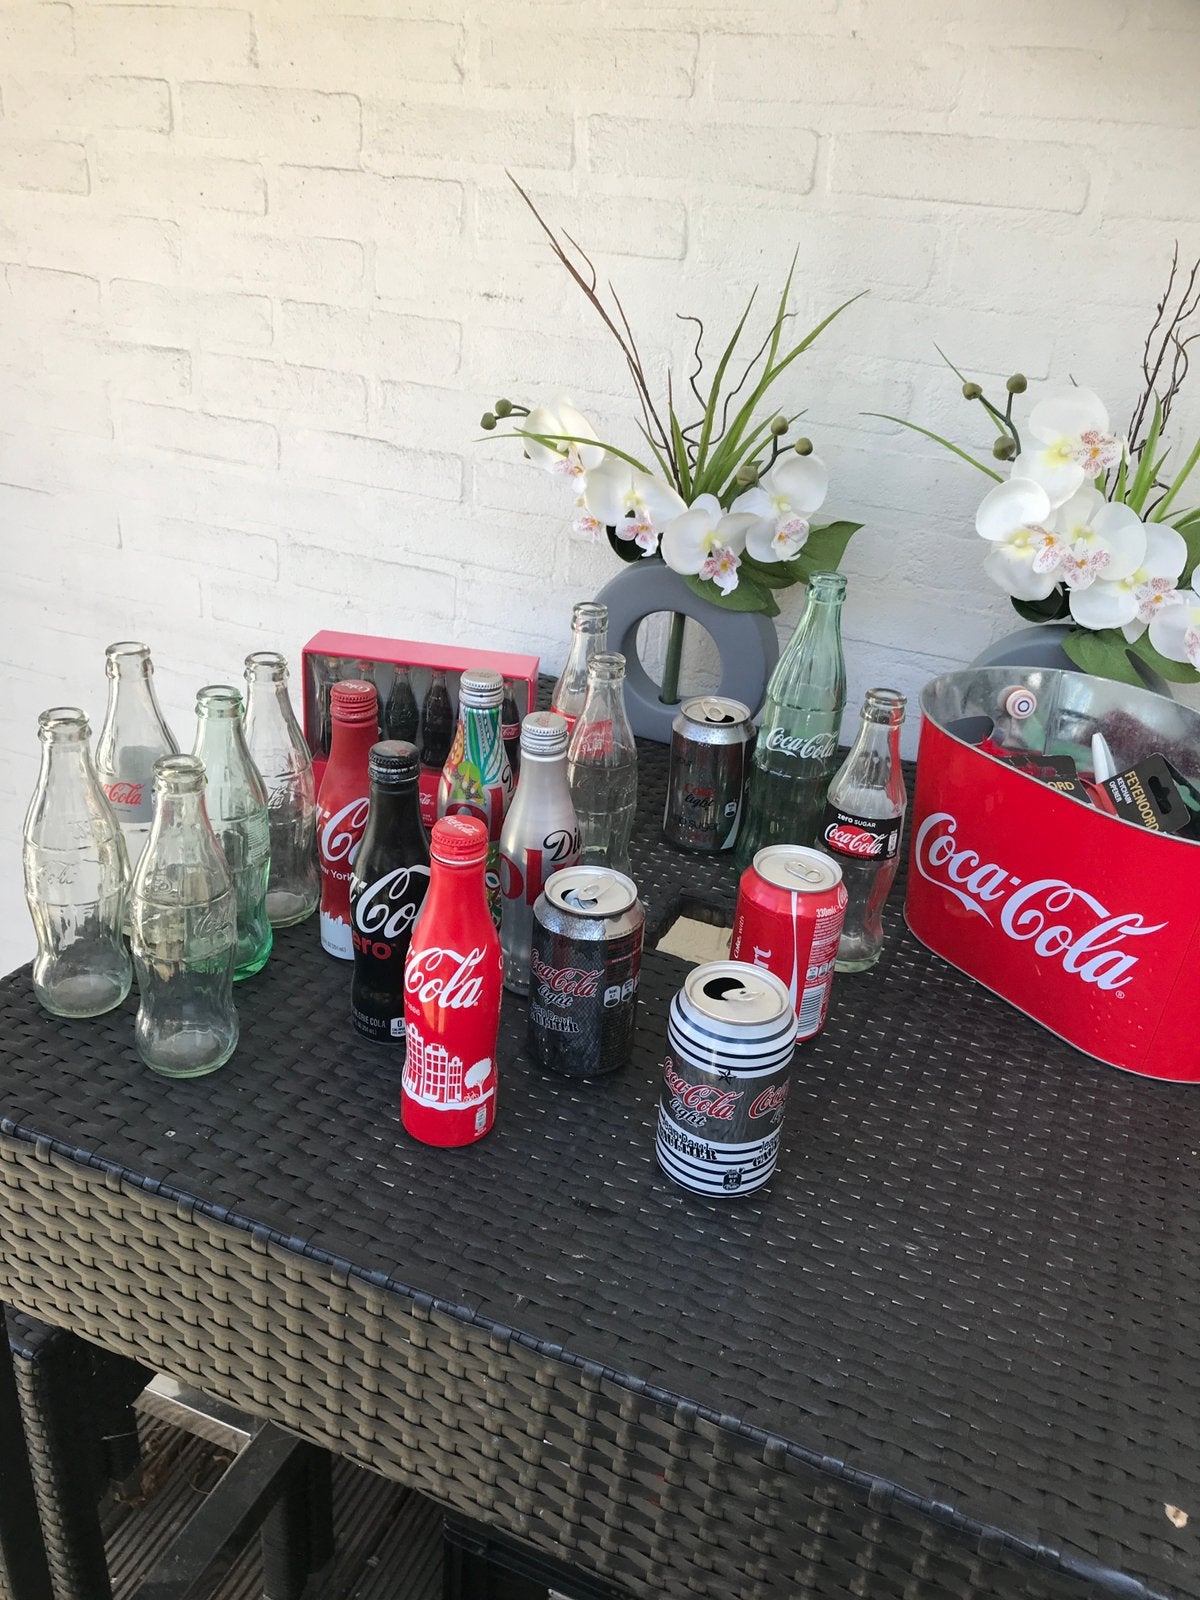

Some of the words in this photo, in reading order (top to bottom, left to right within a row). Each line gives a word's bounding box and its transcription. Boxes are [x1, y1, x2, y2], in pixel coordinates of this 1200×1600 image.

[766, 727, 838, 758] Coca-Cola
[1047, 781, 1075, 791] ORD
[1124, 770, 1159, 831] FEYENOORD
[837, 813, 853, 823] zero
[854, 819, 876, 828] SUGAR
[825, 823, 888, 854] Coca-Cola
[915, 812, 1169, 991] Coca-Cola
[353, 931, 392, 960] ero
[753, 946, 771, 969] rt
[370, 1017, 386, 1028] COLA
